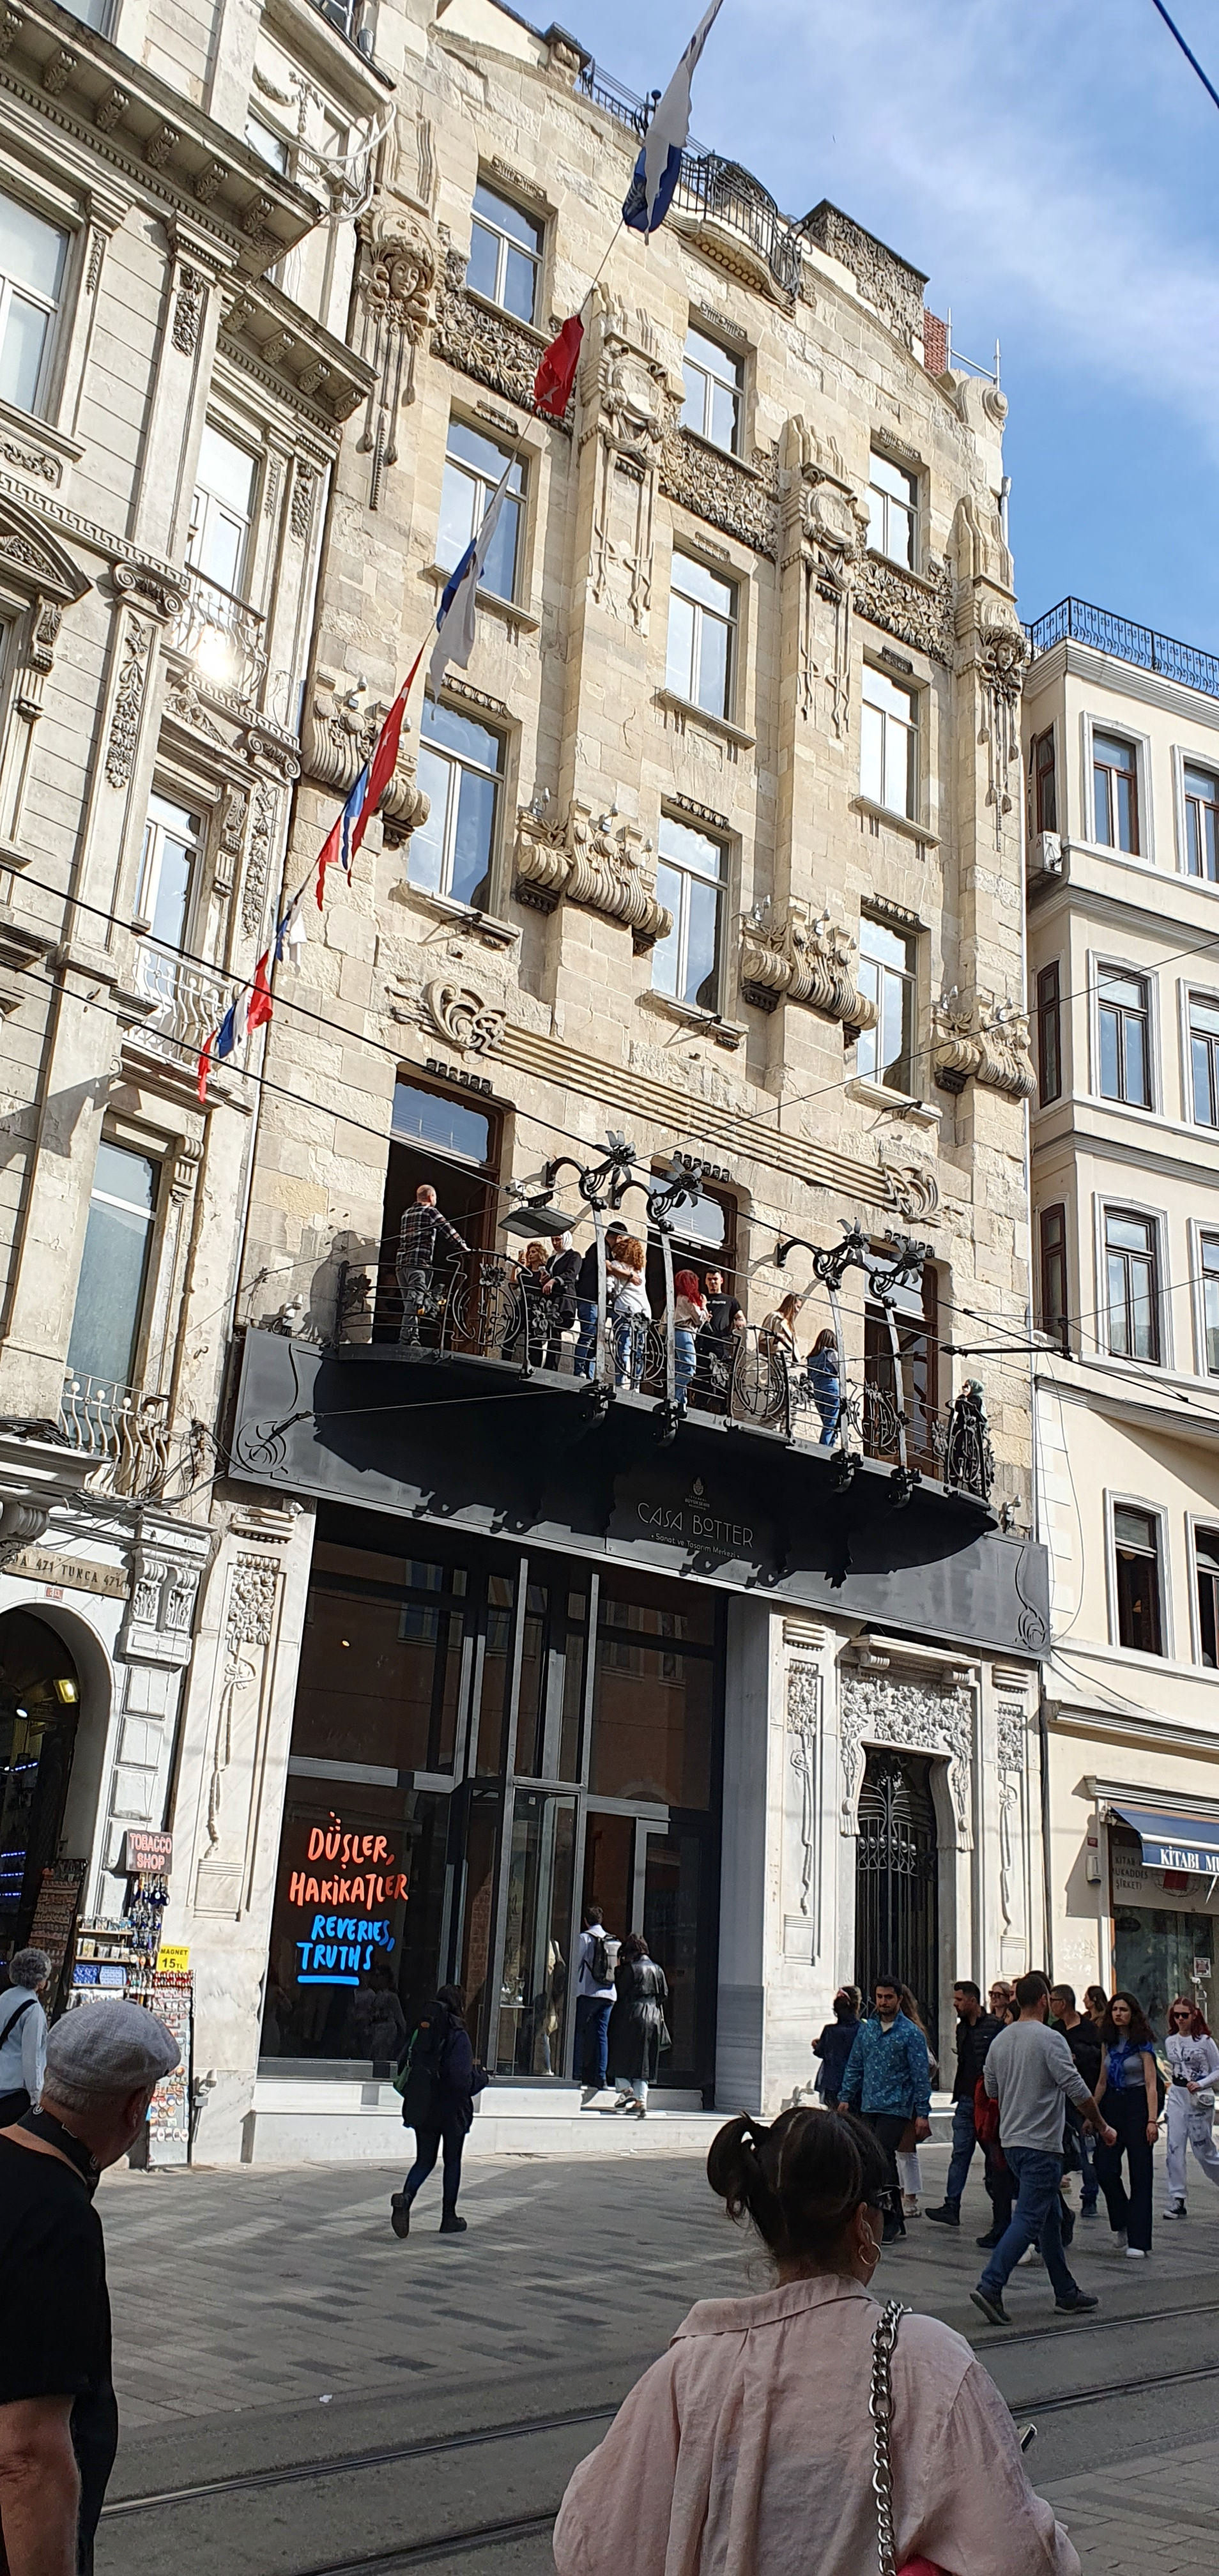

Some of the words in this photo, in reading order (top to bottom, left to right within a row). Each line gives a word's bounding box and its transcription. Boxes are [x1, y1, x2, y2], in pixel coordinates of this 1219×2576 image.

[638, 1503, 682, 1531] CASA
[693, 1515, 753, 1548] BOTTER
[656, 1533, 675, 1544] Sanat
[686, 1540, 711, 1552] Tasarım
[712, 1546, 735, 1558] Merkezi
[36, 1558, 54, 1572] 471
[61, 1564, 98, 1583] TUNCA
[103, 1574, 120, 1588] 471
[130, 1832, 172, 1854] TOBACCO
[307, 1825, 395, 1869] DÜŞLER,
[1160, 1846, 1199, 1869] KİTABI
[137, 1852, 165, 1870] SHOP
[289, 1871, 409, 1910] HAKİKATLER
[311, 1915, 395, 1952] REVERIES,
[296, 1942, 373, 1971] TRUTHS
